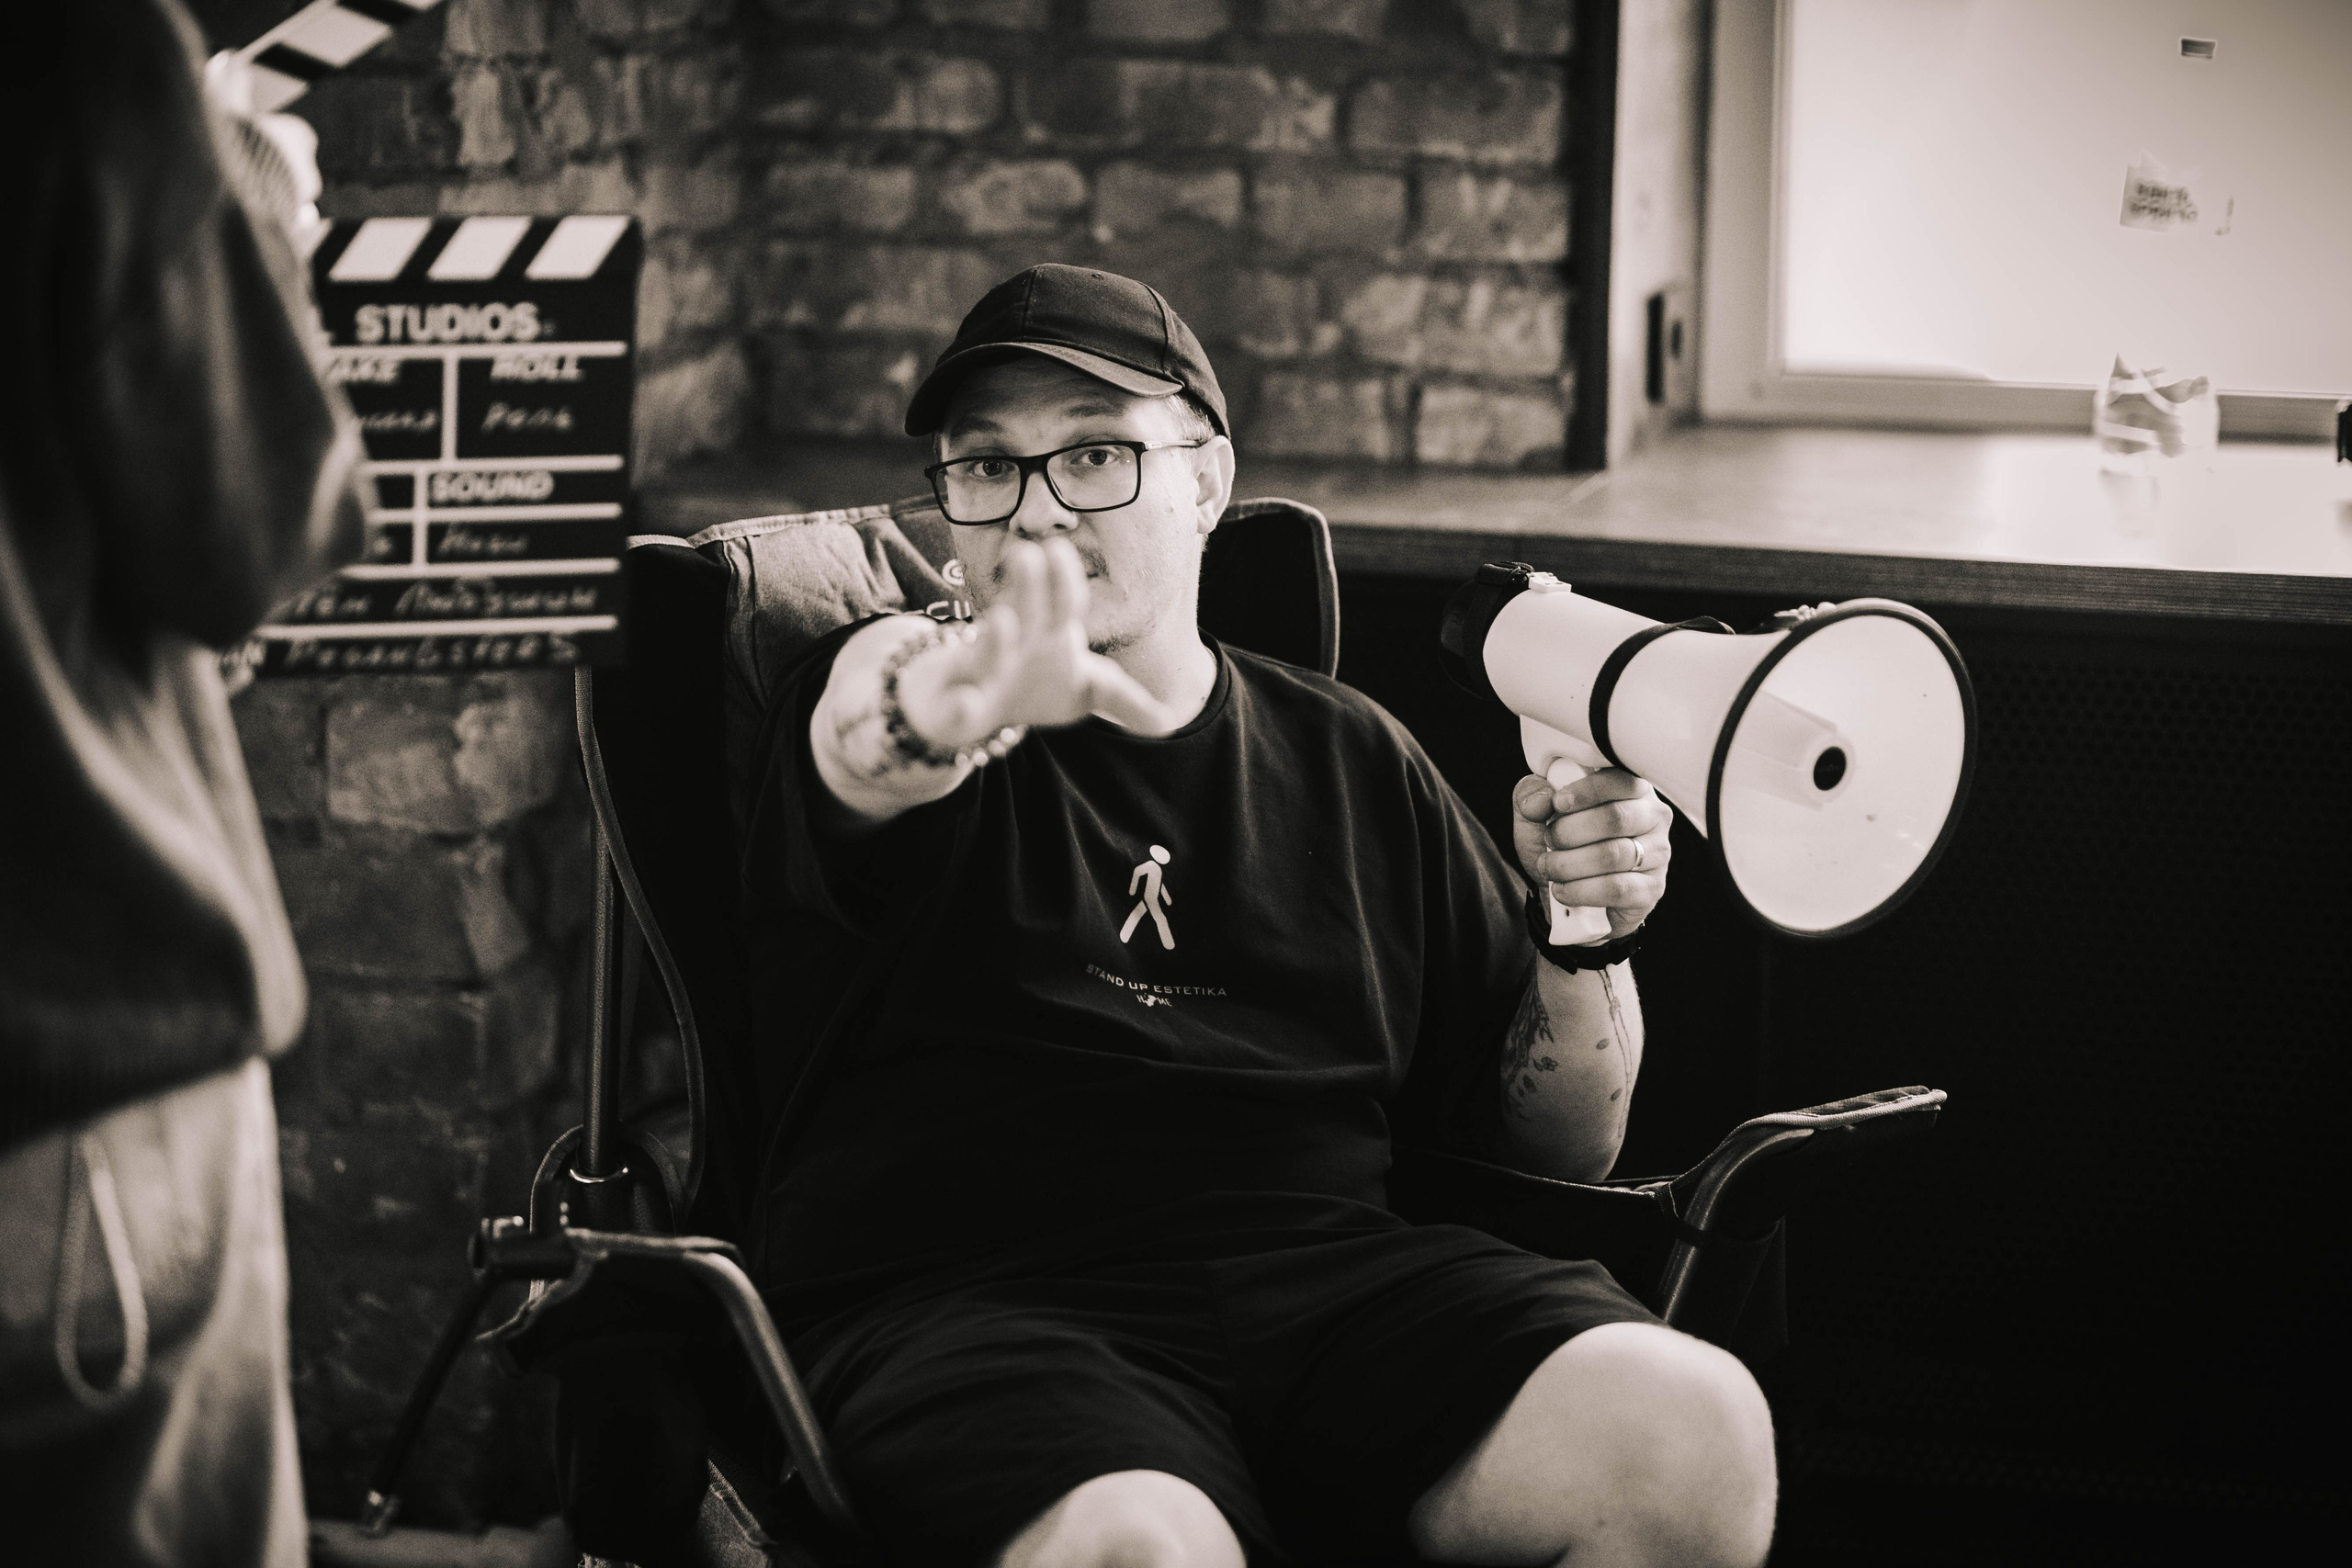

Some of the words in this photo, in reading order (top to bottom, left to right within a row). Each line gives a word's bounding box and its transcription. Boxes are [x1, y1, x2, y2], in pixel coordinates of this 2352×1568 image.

[355, 302, 540, 343] STUDIOS
[324, 355, 401, 385] AKE
[432, 471, 554, 502] SOUND
[1086, 964, 1125, 987] STAND
[1128, 981, 1148, 990] UP
[1153, 985, 1227, 997] ESTETIKA
